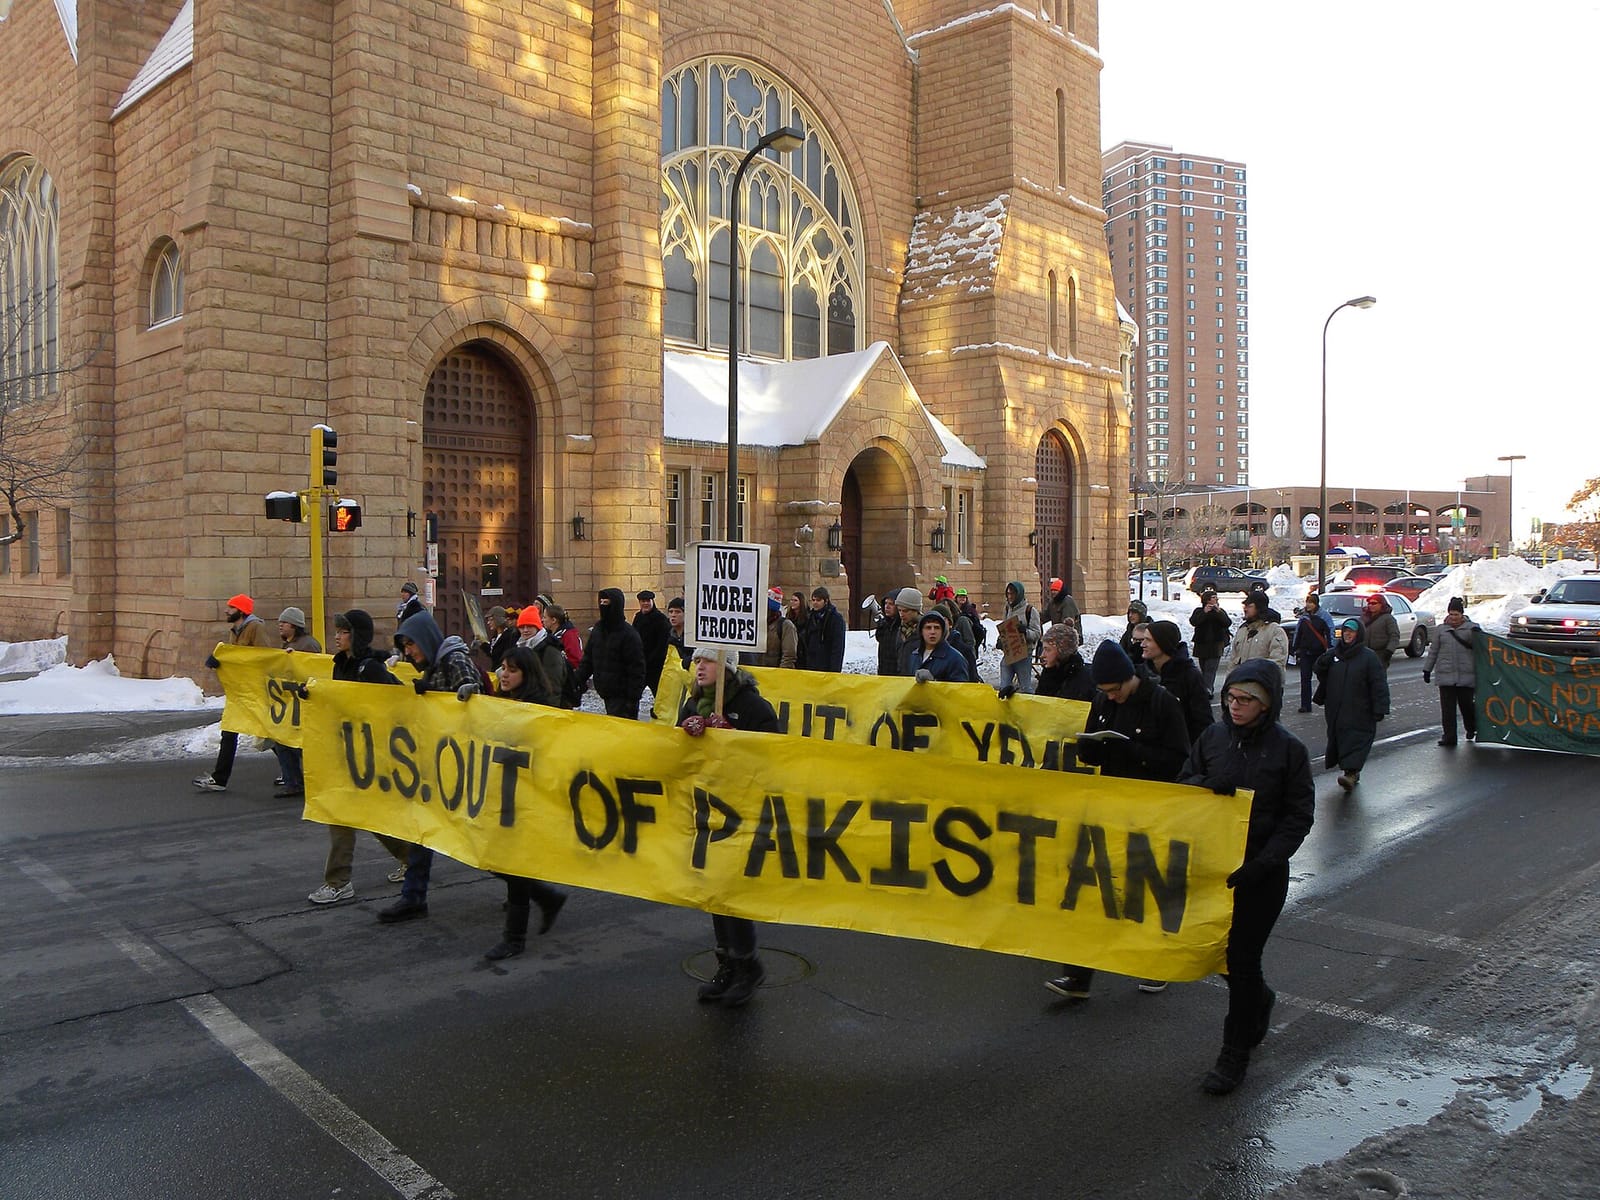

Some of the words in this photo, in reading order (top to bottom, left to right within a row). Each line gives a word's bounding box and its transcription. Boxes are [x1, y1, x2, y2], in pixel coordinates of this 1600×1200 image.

[713, 551, 739, 580] NO
[702, 584, 753, 613] MORE
[699, 615, 755, 641] TROOPS
[1488, 637, 1556, 675] FUND
[569, 770, 664, 854] OF
[691, 787, 1190, 933] PAKISTAN
